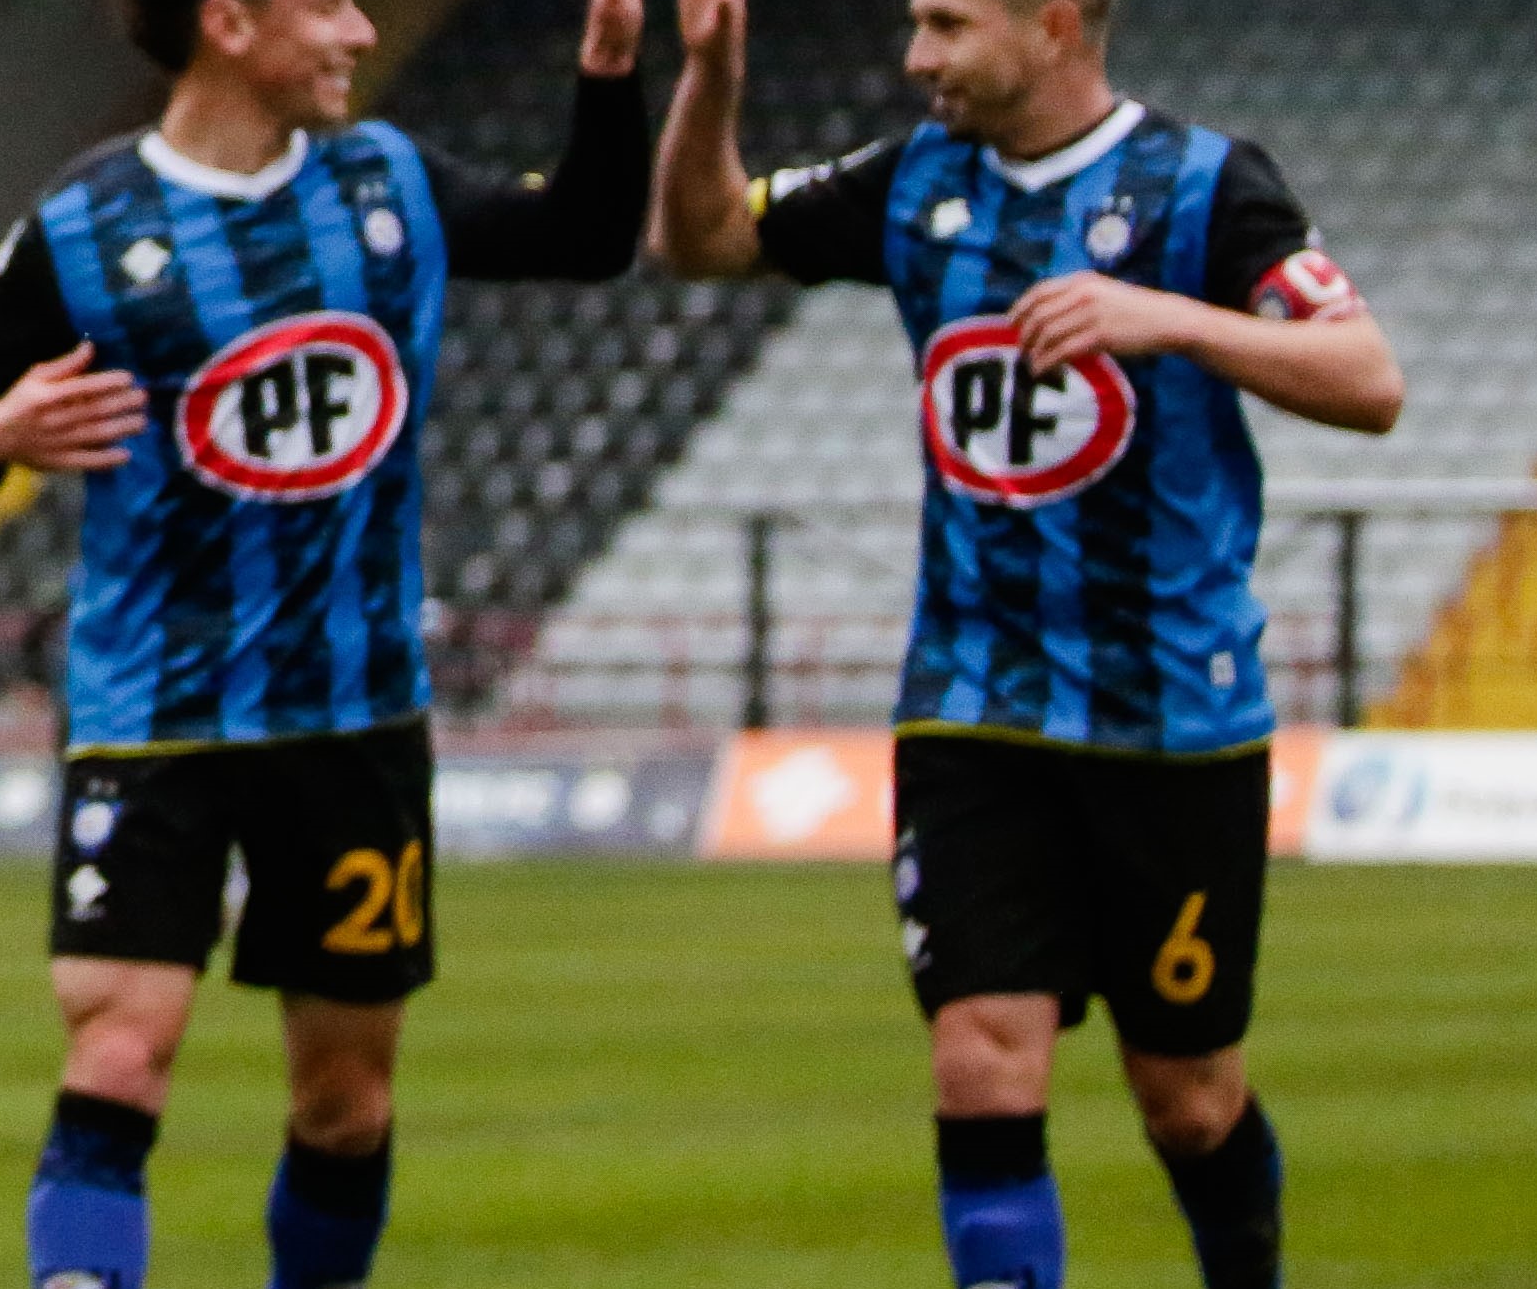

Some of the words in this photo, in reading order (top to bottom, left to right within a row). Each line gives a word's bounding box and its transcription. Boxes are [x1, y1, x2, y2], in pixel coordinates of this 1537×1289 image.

[239, 352, 358, 459] PF
[951, 354, 1067, 467] PF
[1150, 890, 1217, 1005] 6
